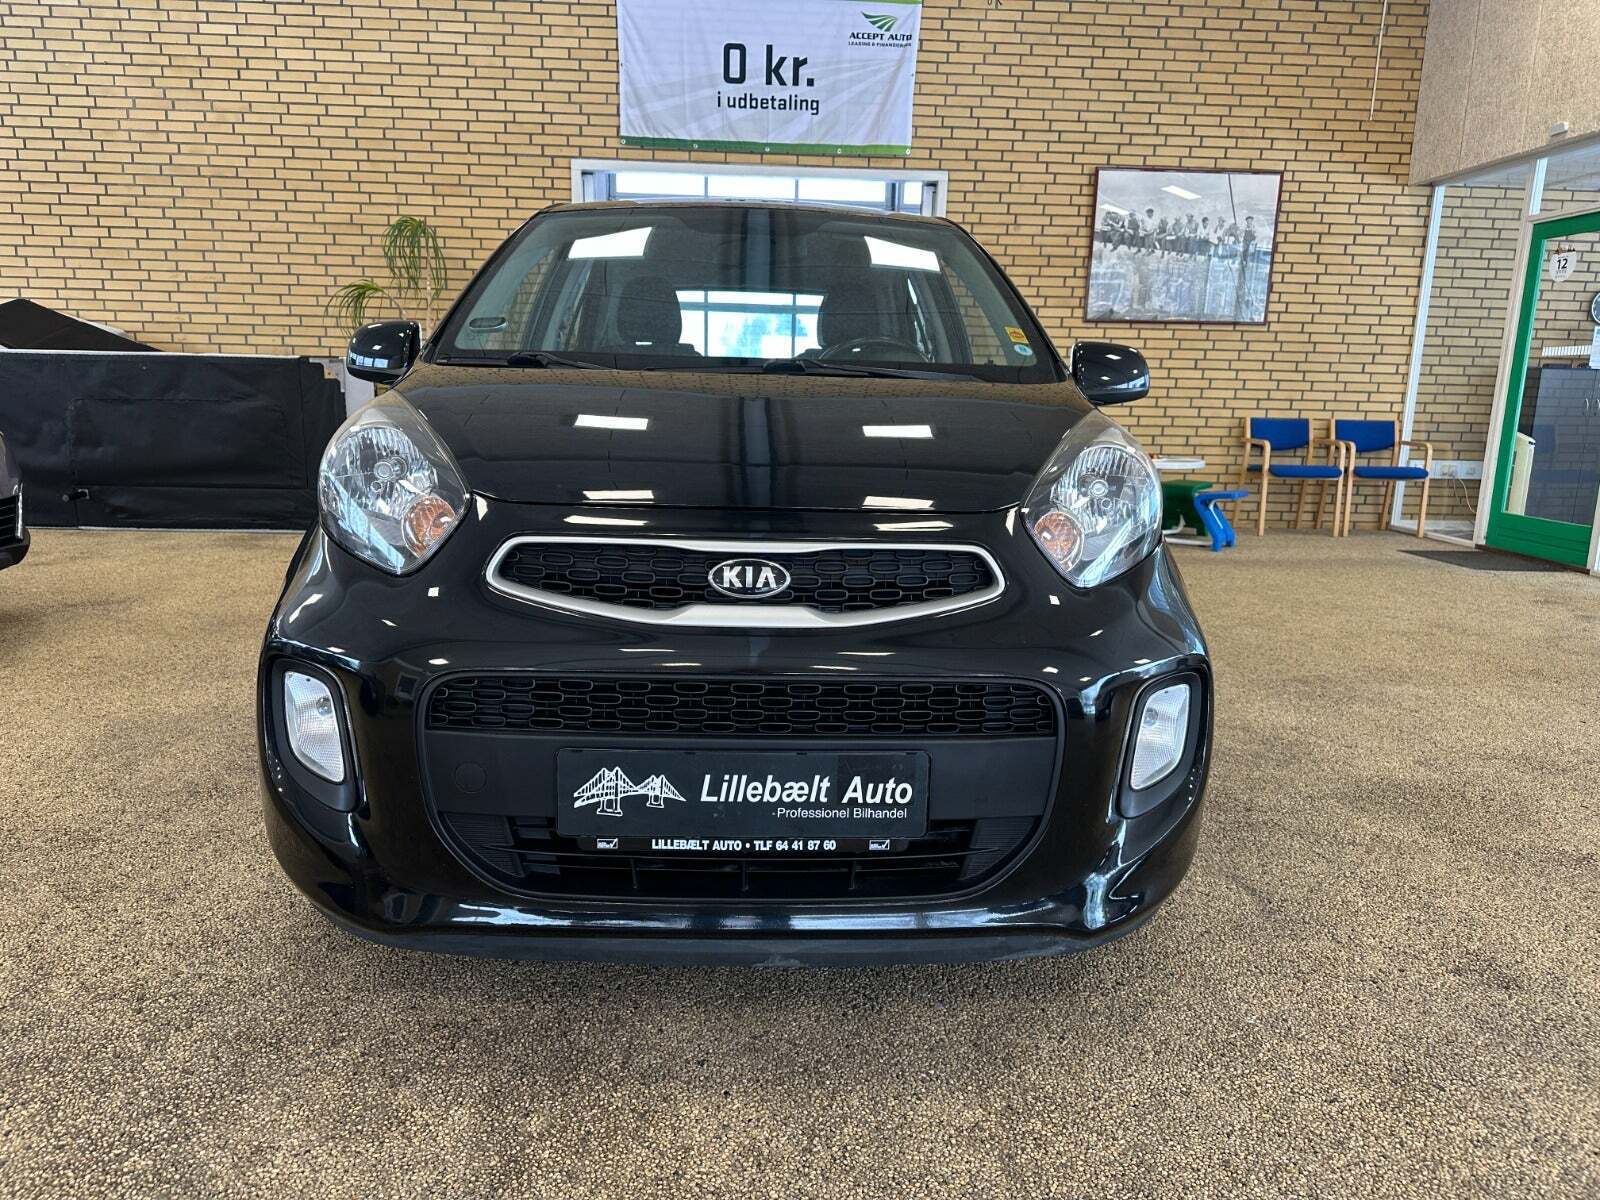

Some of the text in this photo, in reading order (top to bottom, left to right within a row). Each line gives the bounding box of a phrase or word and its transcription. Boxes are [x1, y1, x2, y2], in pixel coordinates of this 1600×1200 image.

[849, 32, 912, 41] ACCEPT AUTO
[723, 43, 815, 87] 0 kr.
[717, 91, 819, 115] i udbetaling
[1557, 258, 1568, 270] 12
[722, 566, 777, 589] KIA
[700, 774, 913, 804] Lillebælt Auto
[777, 808, 907, 819] Professionel Bilhandel
[651, 838, 837, 851] LILLEBÆLT AUTO TLF 64 41 87 60
